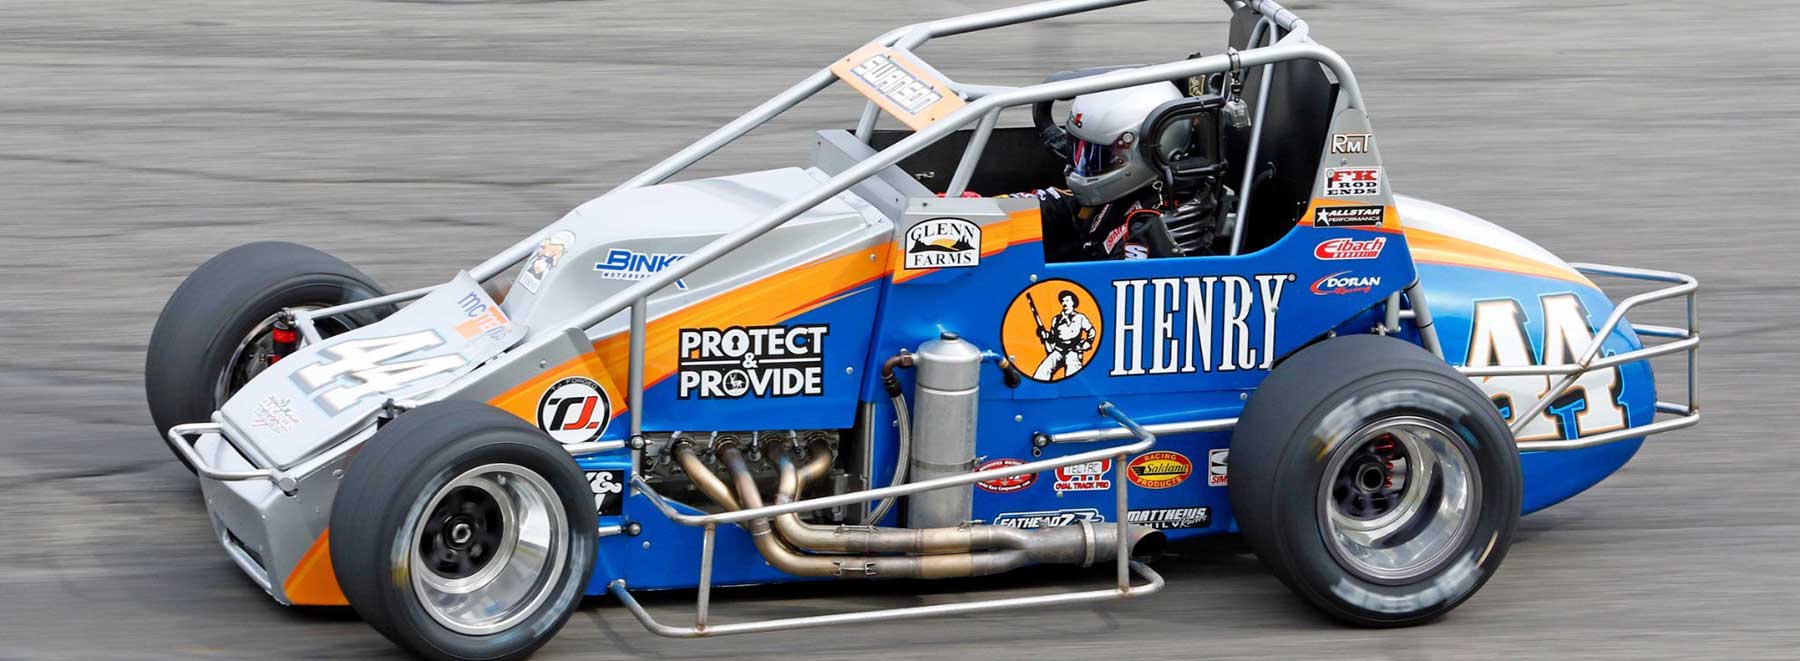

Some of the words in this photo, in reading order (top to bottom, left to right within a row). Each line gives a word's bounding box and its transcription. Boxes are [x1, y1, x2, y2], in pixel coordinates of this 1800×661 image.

[1333, 170, 1377, 181] FK
[1328, 208, 1381, 216] ALLSTAR
[910, 222, 975, 241] GLENN
[1315, 238, 1384, 257] Eibach
[914, 252, 972, 266] FARMS
[596, 250, 686, 284] BINK
[1327, 277, 1381, 287] DORAN
[681, 327, 828, 358] PROTECT
[742, 352, 758, 369] &
[1467, 292, 1628, 440] 44
[289, 328, 470, 418] 44
[680, 367, 822, 397] PROVIDE
[1144, 453, 1177, 461] RACING
[1144, 463, 1187, 474] Saldana
[1096, 481, 1109, 489] PRO
[1136, 477, 1183, 487] PRODUCTS
